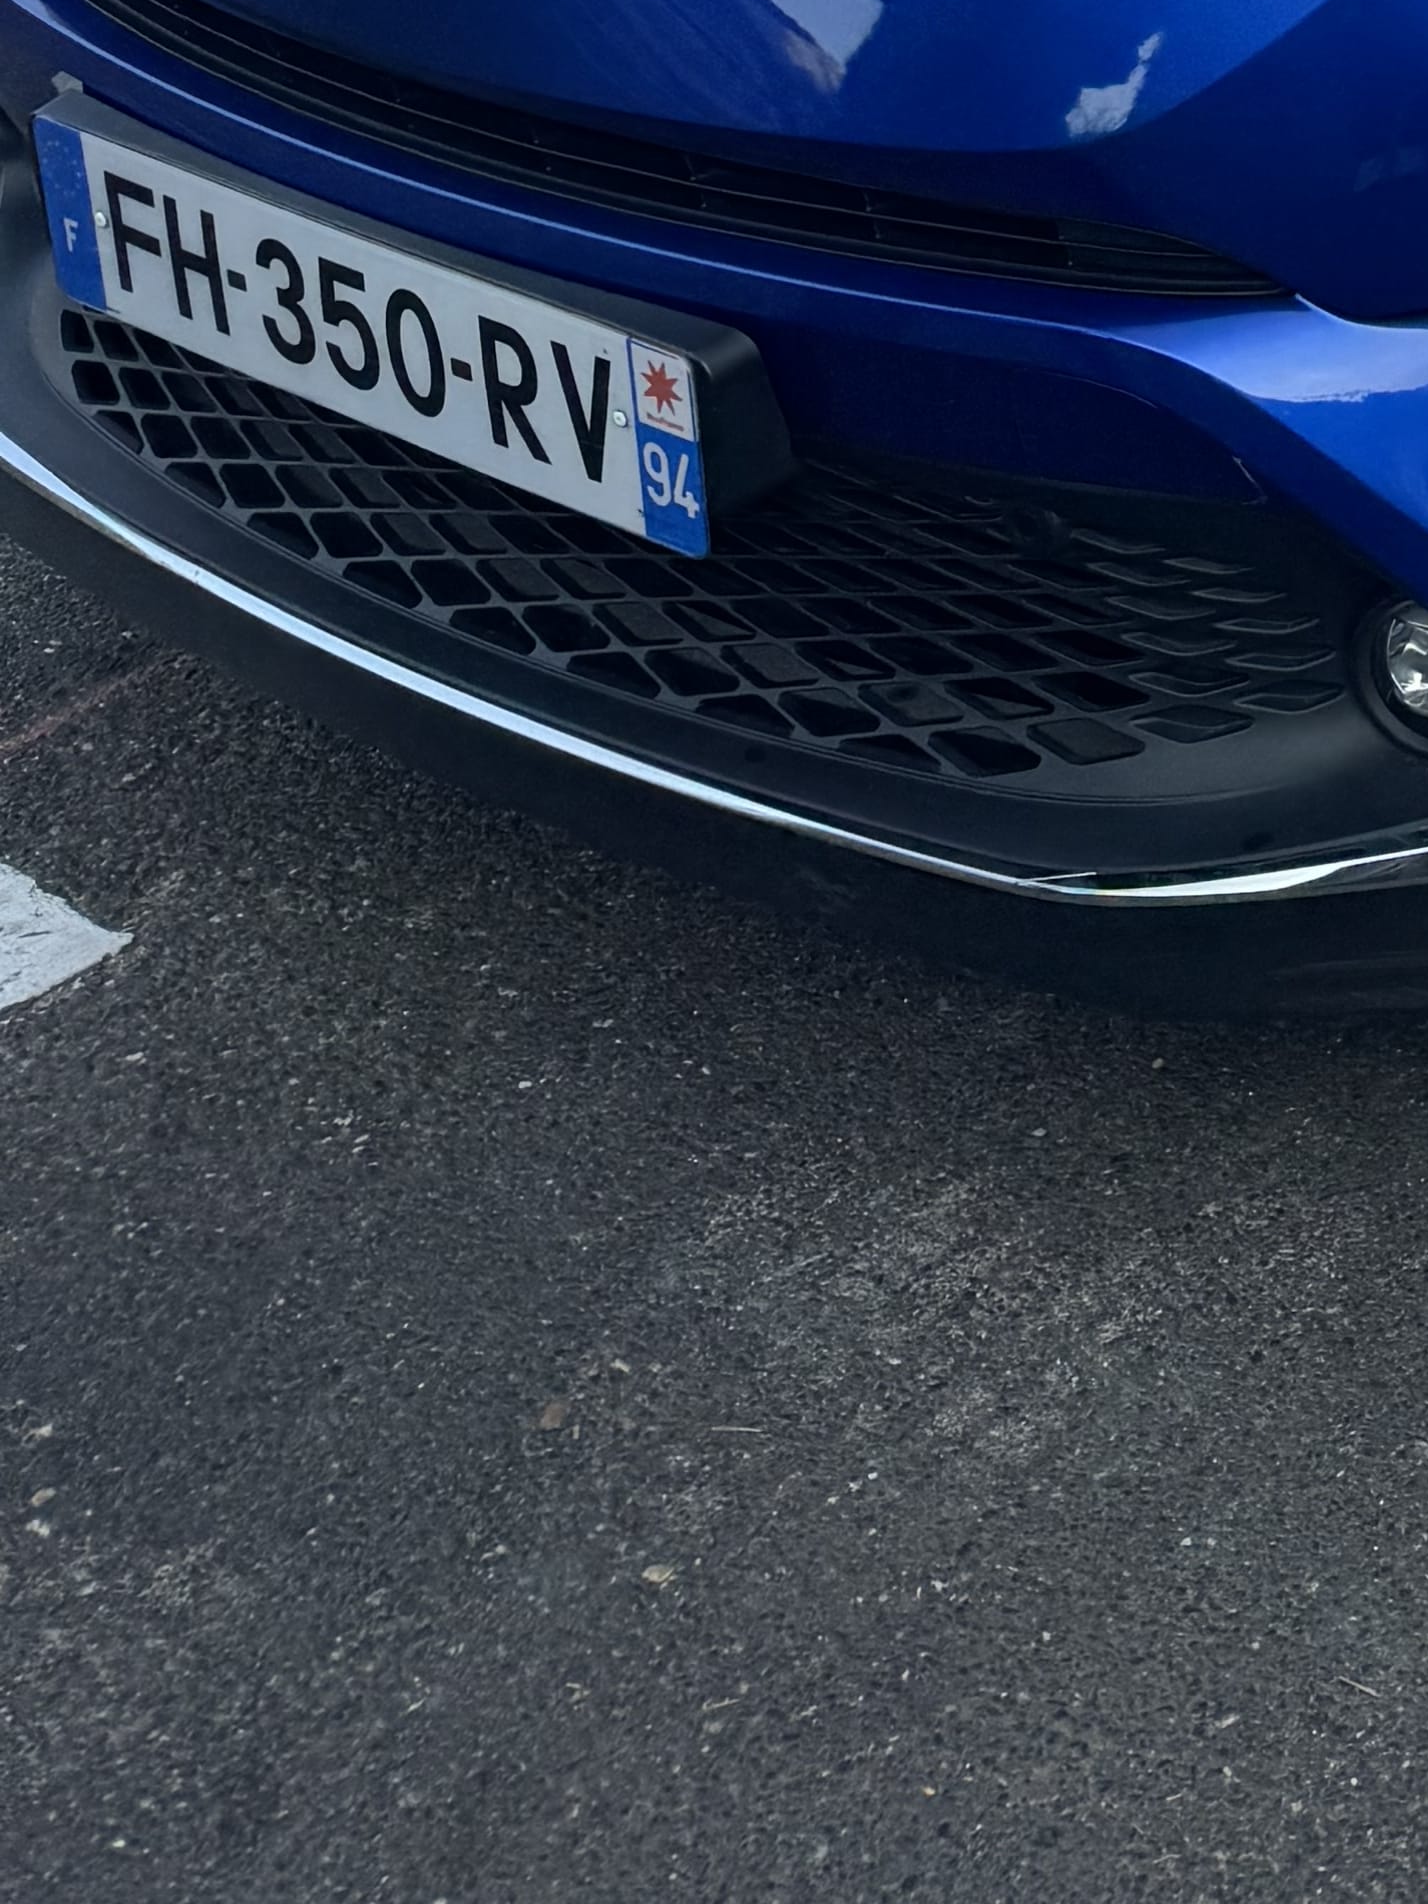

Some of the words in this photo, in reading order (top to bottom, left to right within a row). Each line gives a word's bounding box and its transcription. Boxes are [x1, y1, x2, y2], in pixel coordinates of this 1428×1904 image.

[64, 218, 79, 253] F
[104, 171, 612, 484] FH-350-RV
[643, 441, 700, 520] 94
